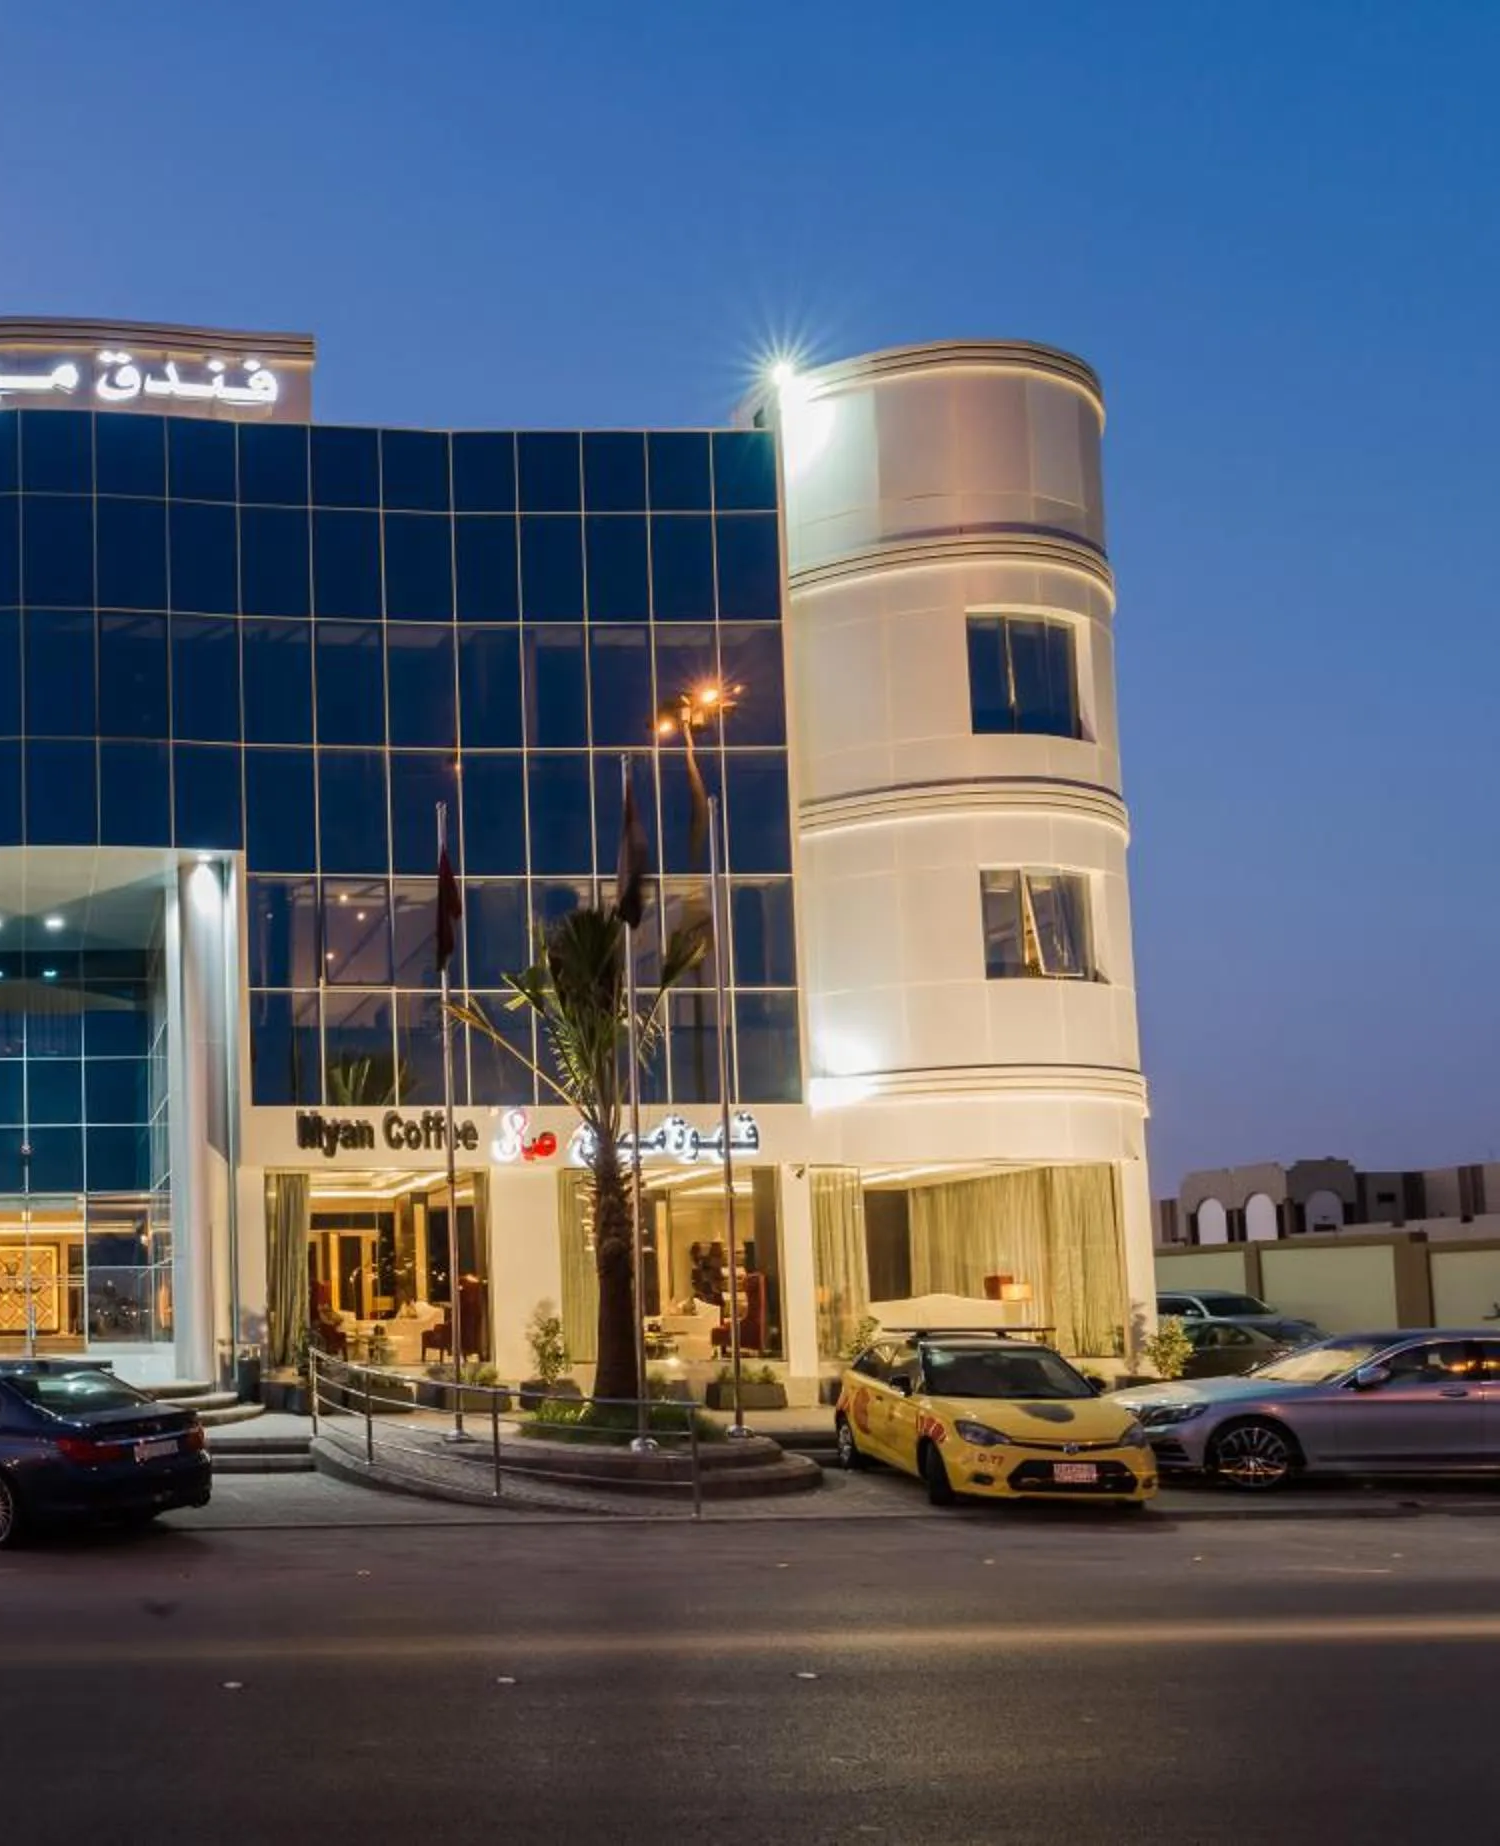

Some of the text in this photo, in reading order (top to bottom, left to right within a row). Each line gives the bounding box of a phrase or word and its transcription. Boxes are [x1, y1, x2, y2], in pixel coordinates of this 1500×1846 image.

[95, 350, 280, 405] فندق
[295, 1109, 375, 1158] Myan
[672, 1110, 760, 1161] قهوة
